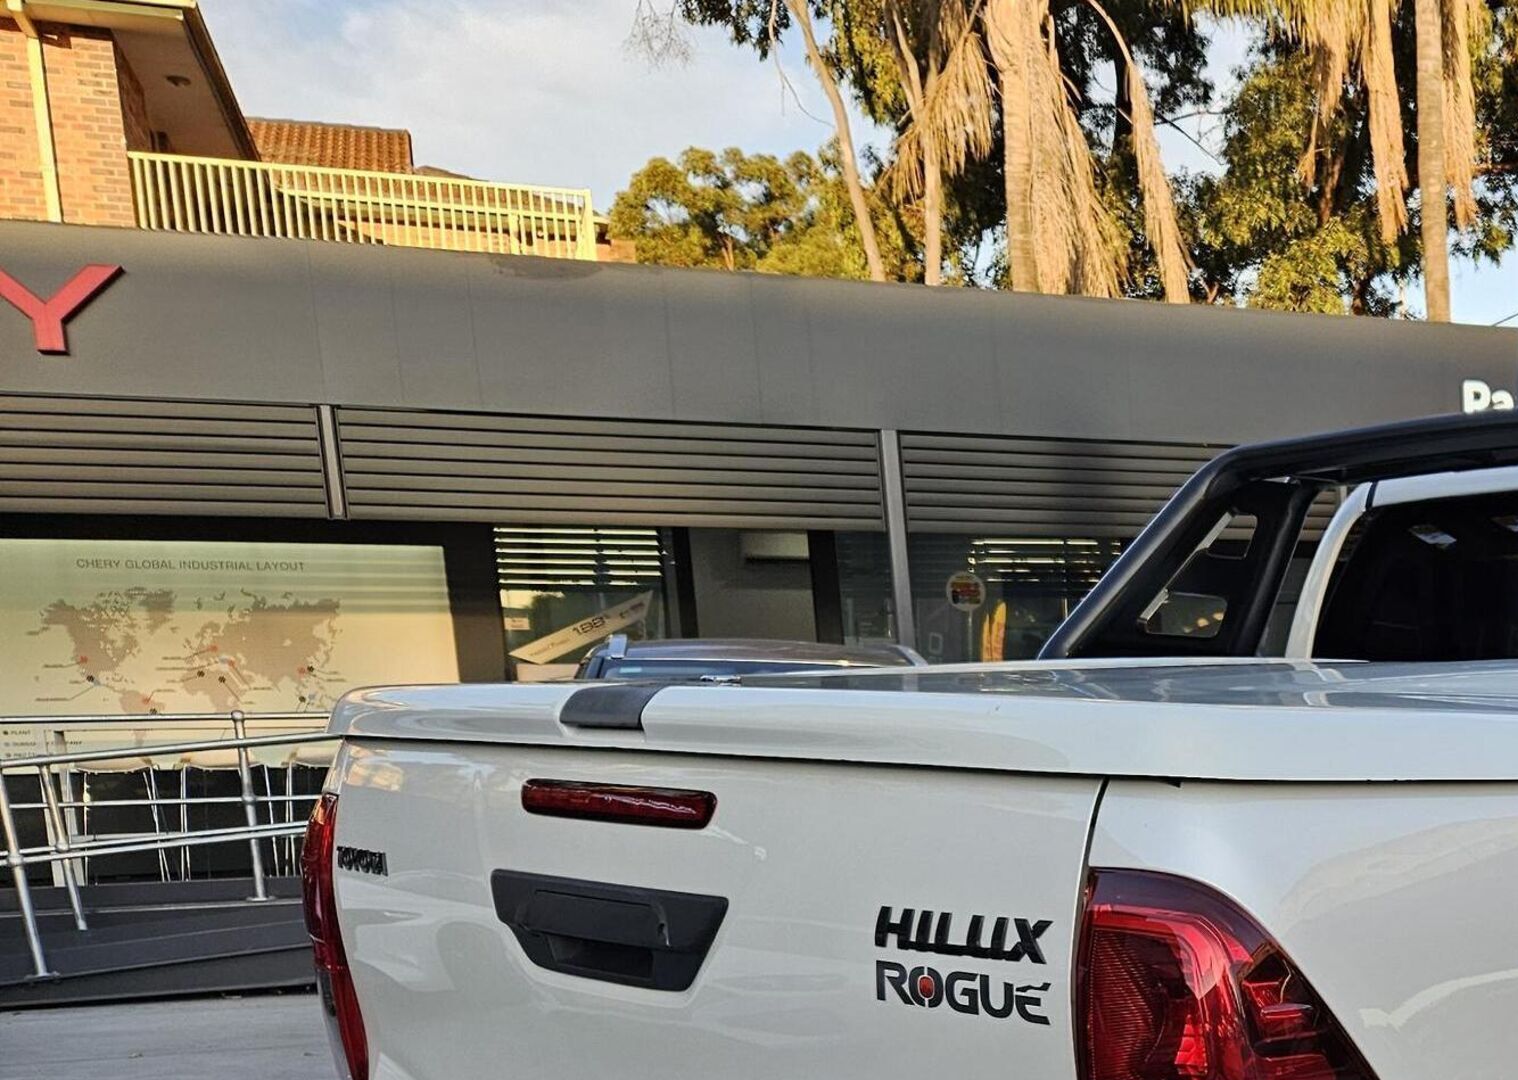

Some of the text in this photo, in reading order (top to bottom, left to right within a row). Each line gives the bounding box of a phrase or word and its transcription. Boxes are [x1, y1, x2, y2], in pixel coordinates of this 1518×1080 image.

[76, 558, 305, 572] CHERY GLOBAL INDUSTRIAL LAYOUT
[337, 845, 388, 877] TOYOTA
[874, 905, 1054, 965] HILUX
[875, 959, 1052, 1026] ROGUE
